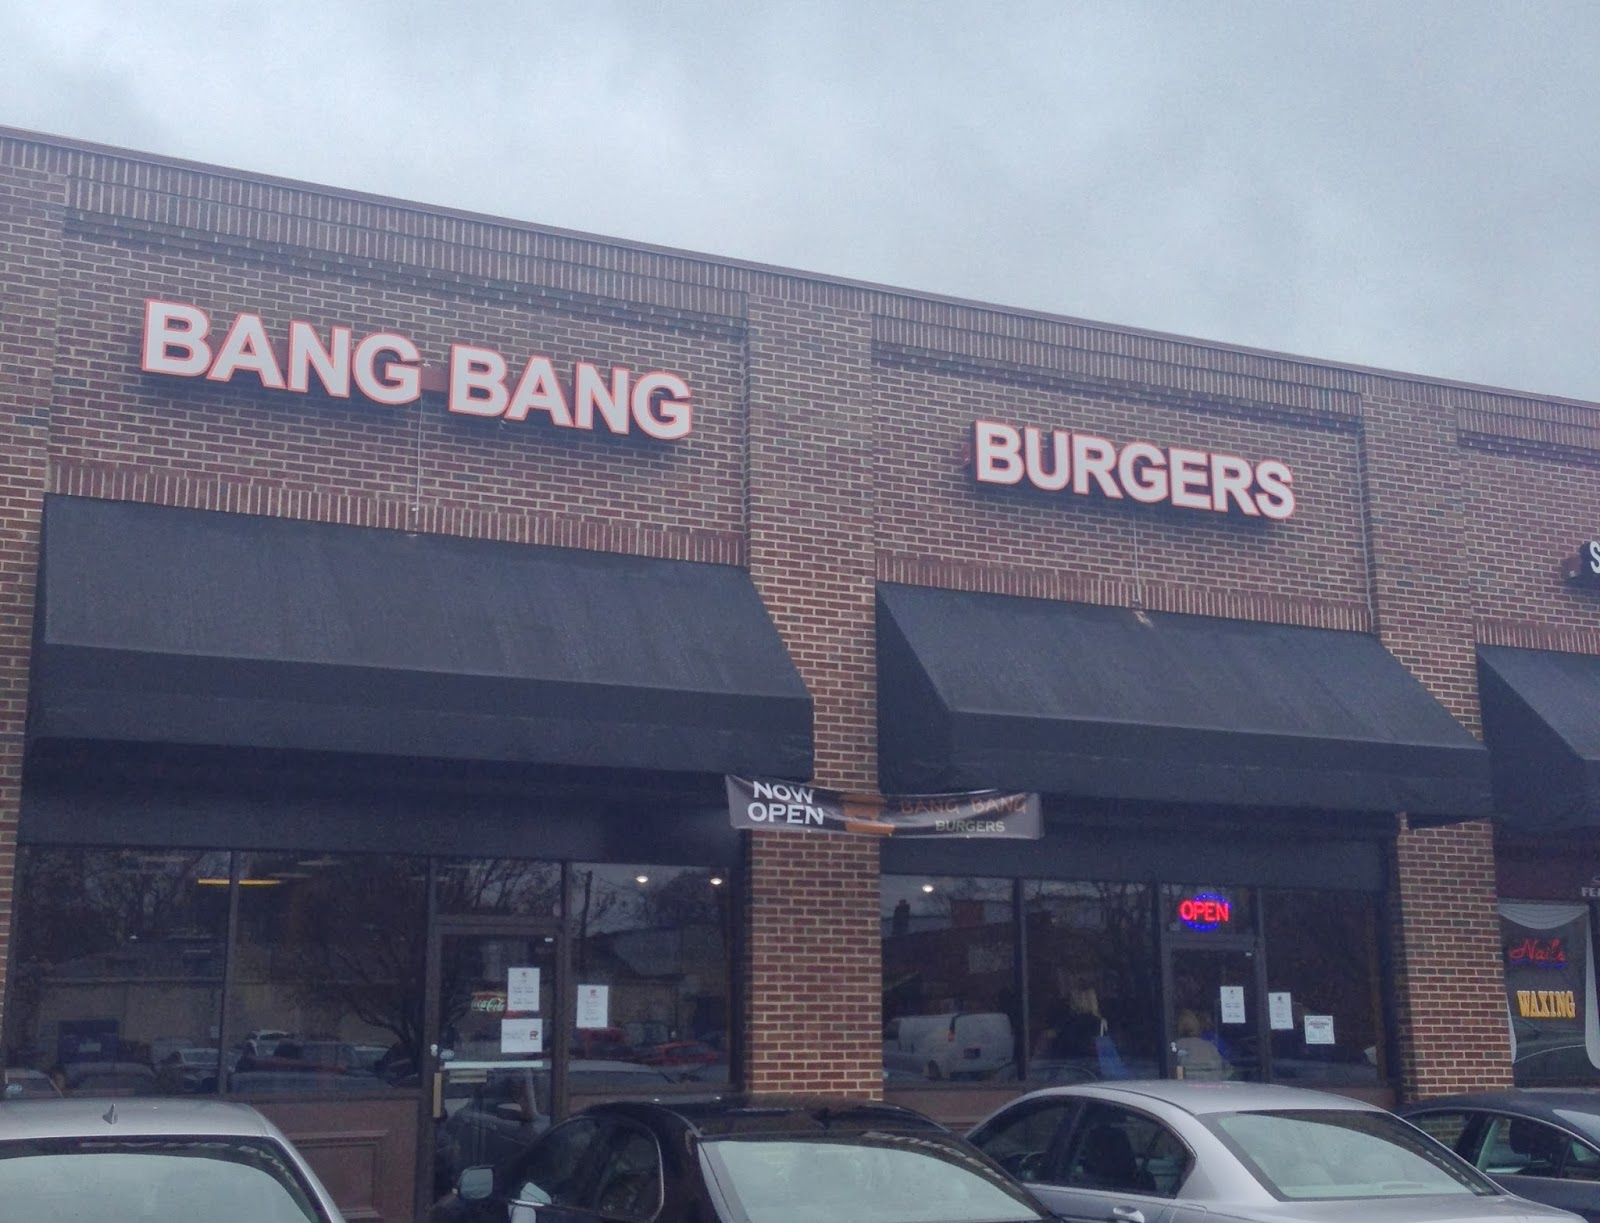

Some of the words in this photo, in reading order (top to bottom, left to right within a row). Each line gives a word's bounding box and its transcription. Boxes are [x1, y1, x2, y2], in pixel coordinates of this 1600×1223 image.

[142, 299, 422, 405] BANG
[448, 343, 693, 440] BANG
[974, 419, 1296, 520] BURGERS
[752, 781, 816, 804] NOW
[901, 800, 960, 815] BANG
[971, 792, 1027, 815] BANG
[747, 801, 824, 826] OPEN
[935, 820, 1006, 833] BURGERS
[1581, 887, 1600, 897] FE
[1179, 899, 1230, 922] OPEN
[1517, 990, 1576, 1018] WAXING
